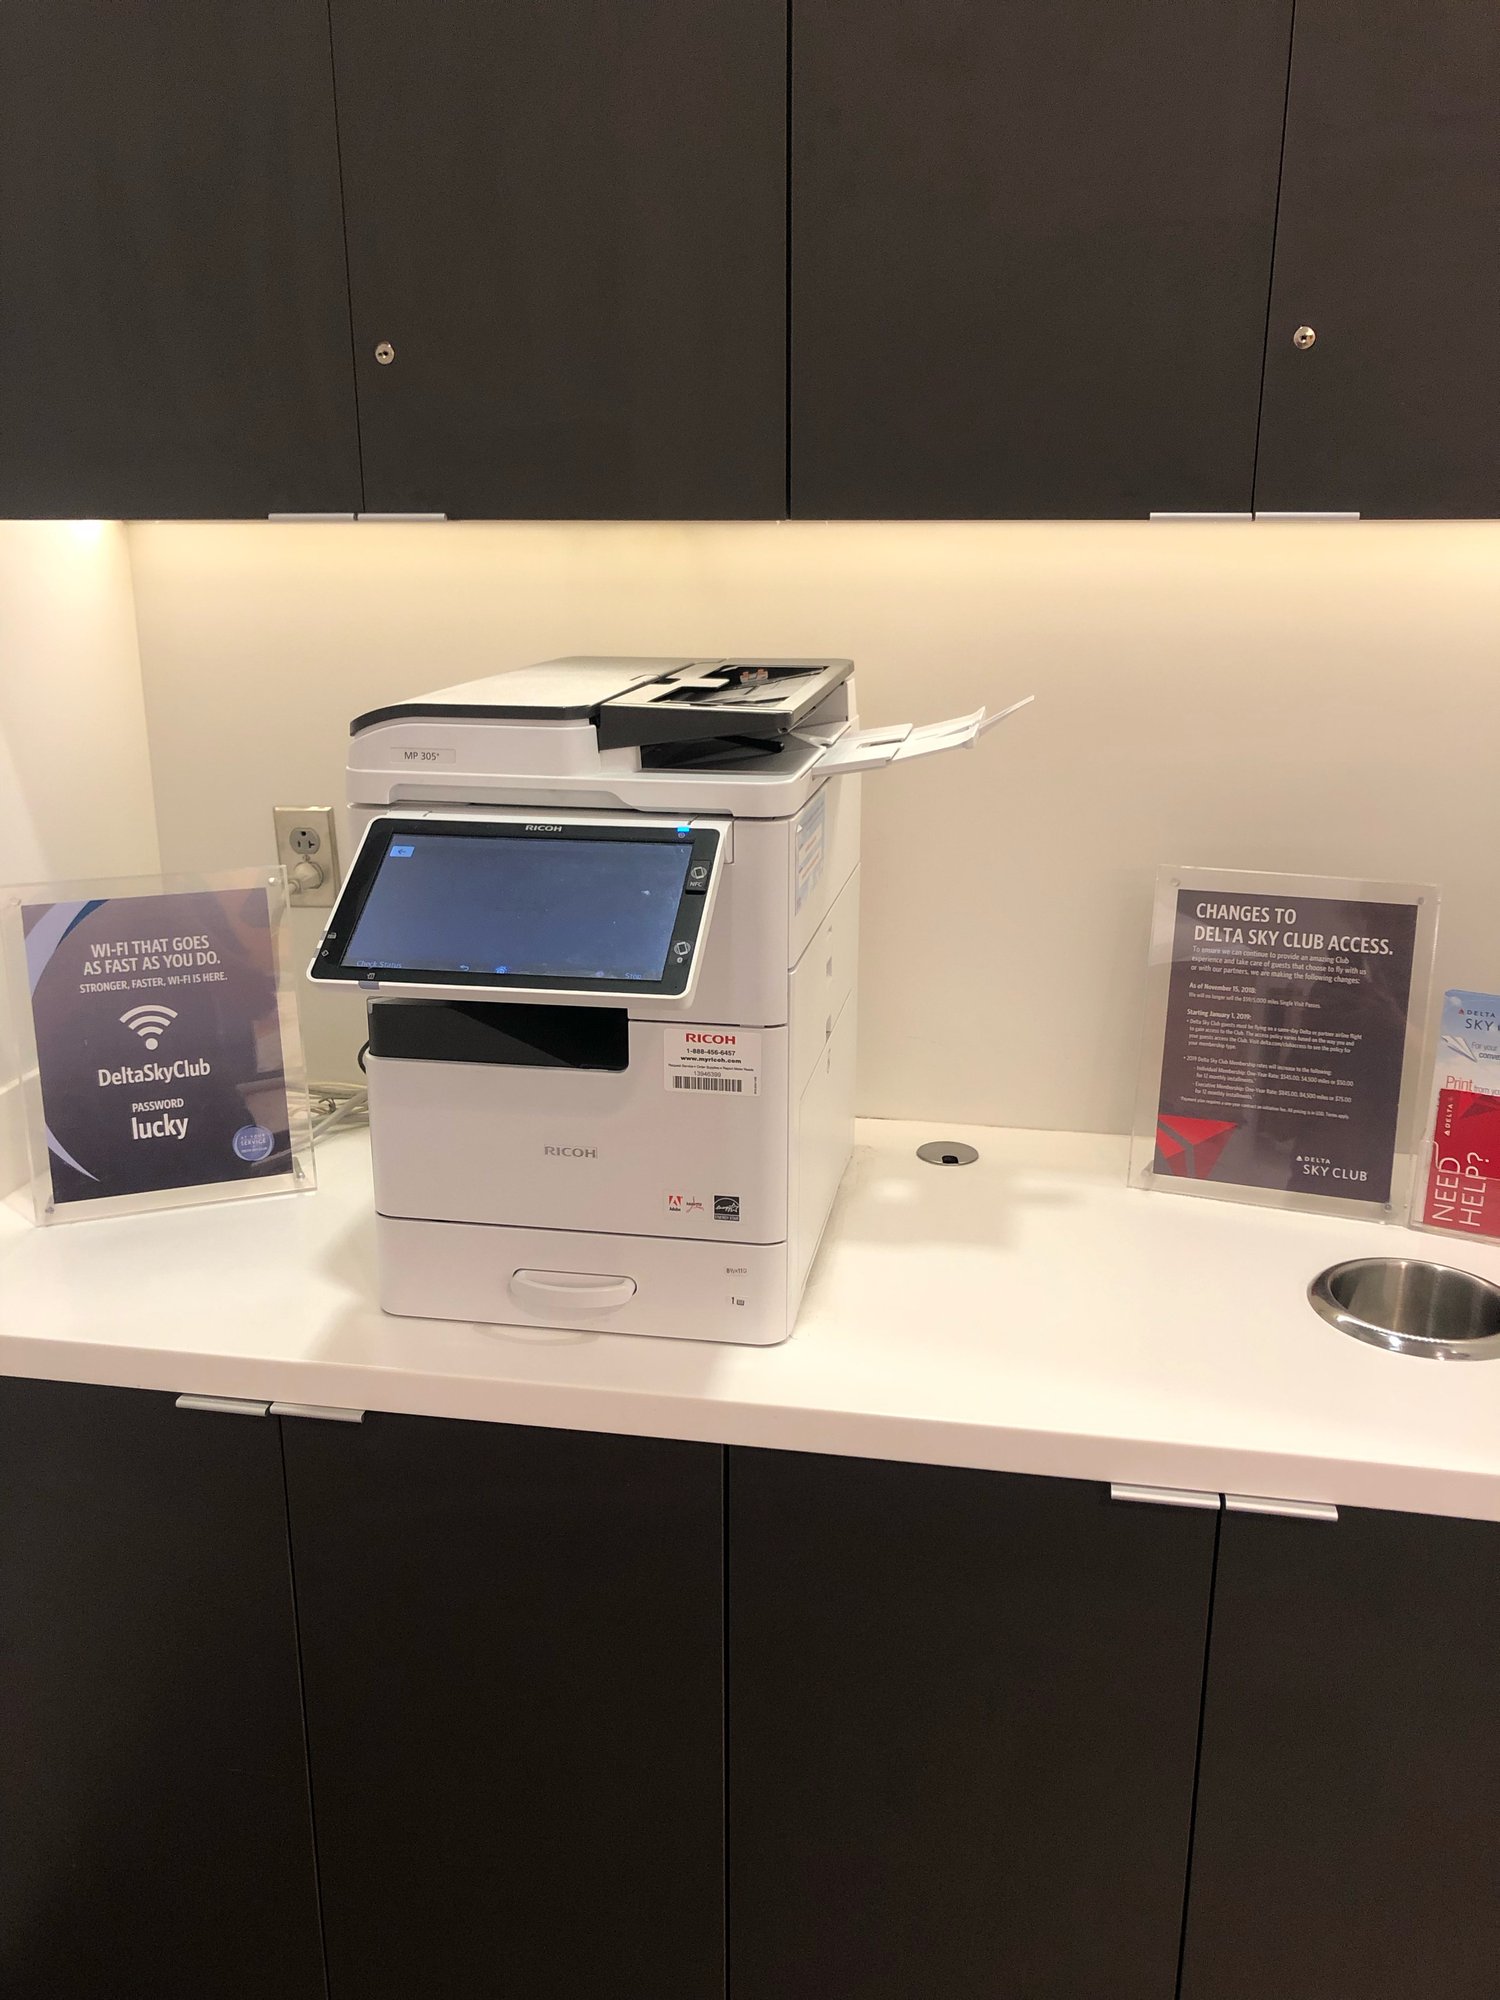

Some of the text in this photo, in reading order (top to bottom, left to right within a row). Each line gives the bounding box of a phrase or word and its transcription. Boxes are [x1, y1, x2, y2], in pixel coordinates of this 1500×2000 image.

[404, 752, 418, 760] MP
[525, 824, 562, 832] RICOH
[1196, 902, 1297, 924] CHANGES TO
[91, 934, 210, 958] WI-FI THAT GOES
[1194, 925, 1394, 956] DELTA SKY CLUB ACCESS.
[1193, 945, 1200, 953] To
[1243, 949, 1268, 958] continue
[1277, 952, 1299, 962] provide
[1310, 954, 1334, 964] amazing
[1336, 956, 1349, 964] Club
[84, 950, 221, 976] AS FAST AS YOU DO.
[356, 959, 378, 969] Check
[1271, 961, 1290, 970] guests
[1292, 962, 1304, 970] that
[1306, 964, 1326, 972] choose
[625, 972, 642, 980] Stop
[1199, 964, 1211, 972] with
[1271, 970, 1292, 980] making
[1294, 971, 1304, 979] the
[1305, 972, 1332, 983] following
[80, 972, 228, 994] STRONGER, FASTER, WI-FI IS HERE.
[1204, 983, 1232, 992] November
[1187, 1008, 1208, 1018] Starting
[1210, 1010, 1230, 1020] January
[1467, 1009, 1496, 1018] DELTA
[1465, 1018, 1494, 1031] SKY
[686, 1033, 736, 1044] RICOH
[687, 1048, 736, 1056] 1-888-456-6457
[680, 1056, 742, 1064] www.myricoh.com
[98, 1058, 211, 1087] DeltaSkyClub
[1446, 1076, 1472, 1091] Print
[132, 1098, 184, 1112] PASSWORD
[1445, 1104, 1454, 1129] DELTA
[132, 1113, 188, 1140] lucky
[544, 1146, 596, 1158] RICOH
[1304, 1156, 1330, 1164] DELTA
[1303, 1164, 1368, 1181] SKY CLUB
[1432, 1157, 1460, 1222] NEED
[1459, 1152, 1490, 1226] HELP?
